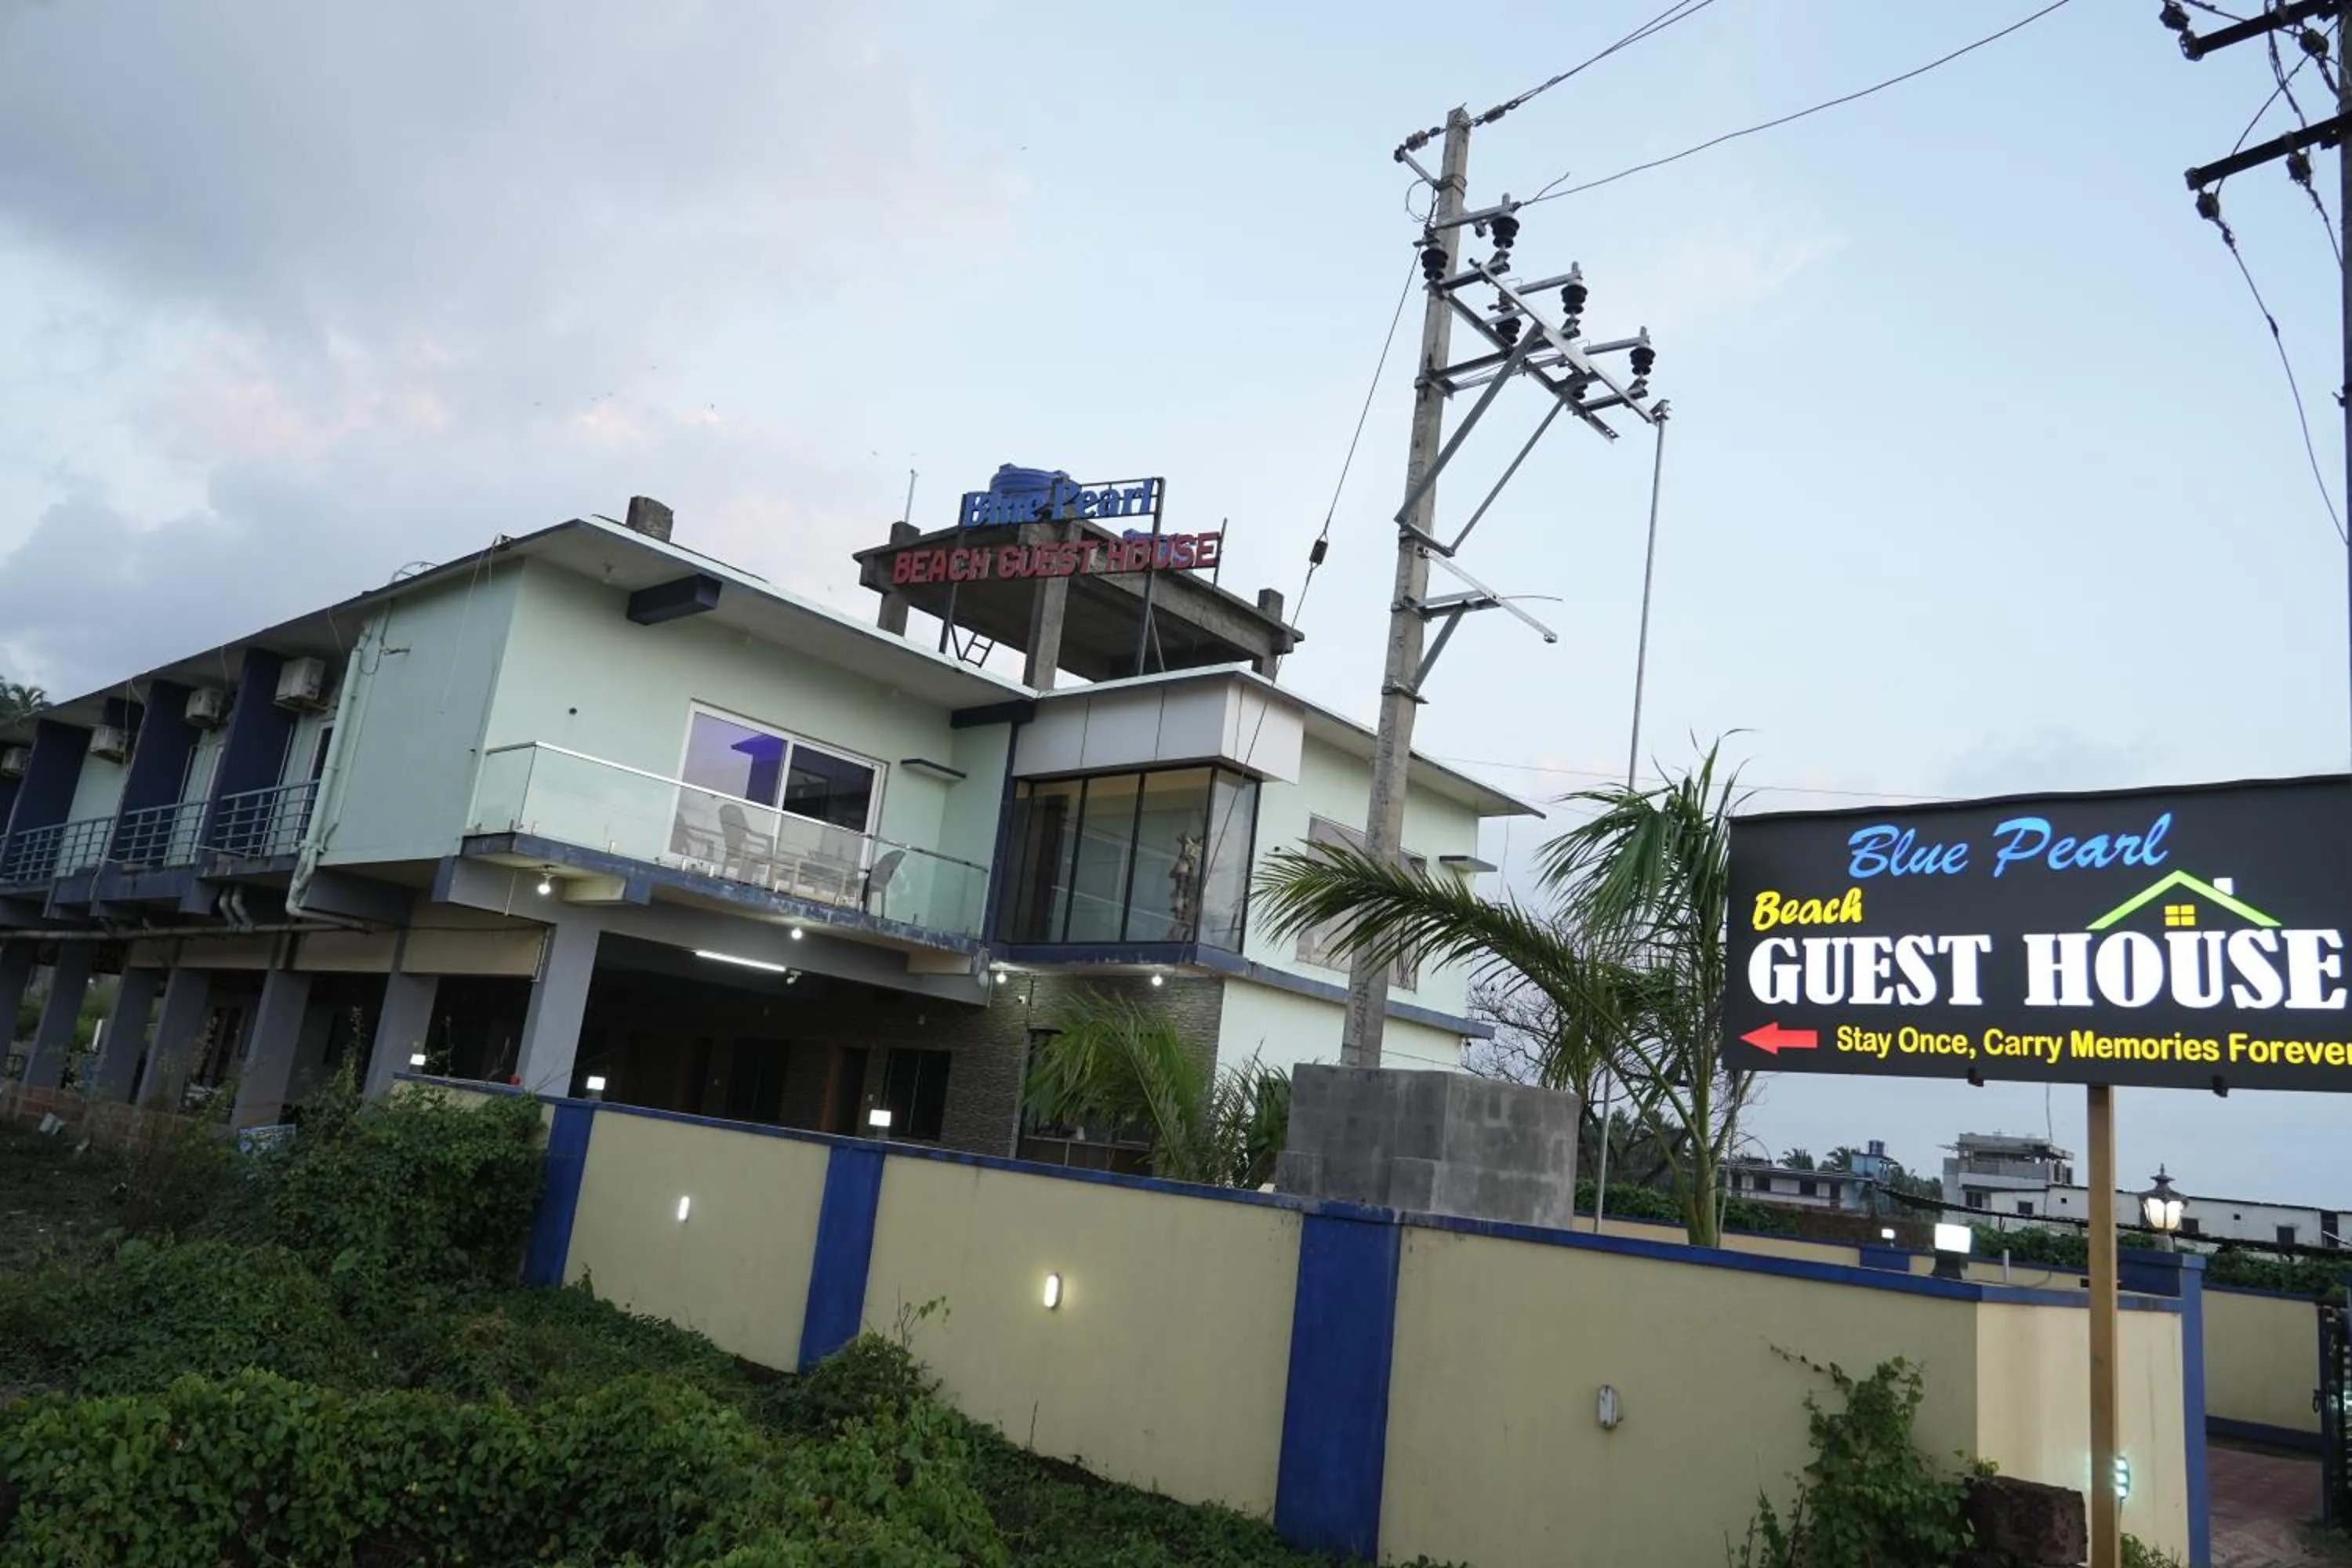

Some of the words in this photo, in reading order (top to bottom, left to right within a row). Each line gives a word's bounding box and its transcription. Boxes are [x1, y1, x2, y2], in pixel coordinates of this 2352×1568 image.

[963, 486, 1049, 528] Blue
[1051, 477, 1156, 521] Pearl
[892, 547, 992, 585] BEACH
[996, 539, 1101, 579] GUEST
[1105, 532, 1221, 574] HOUSE
[1848, 823, 1970, 880] Blue
[1991, 812, 2175, 879] Pearl
[1751, 887, 1863, 931] Beach
[1748, 934, 1992, 1006] GUEST
[2023, 927, 2348, 1010] HOUSE
[1837, 1025, 1893, 1059] Stay
[1898, 1026, 1976, 1058] Once,
[1983, 1028, 2063, 1064] Carry
[2070, 1029, 2220, 1062] Memories
